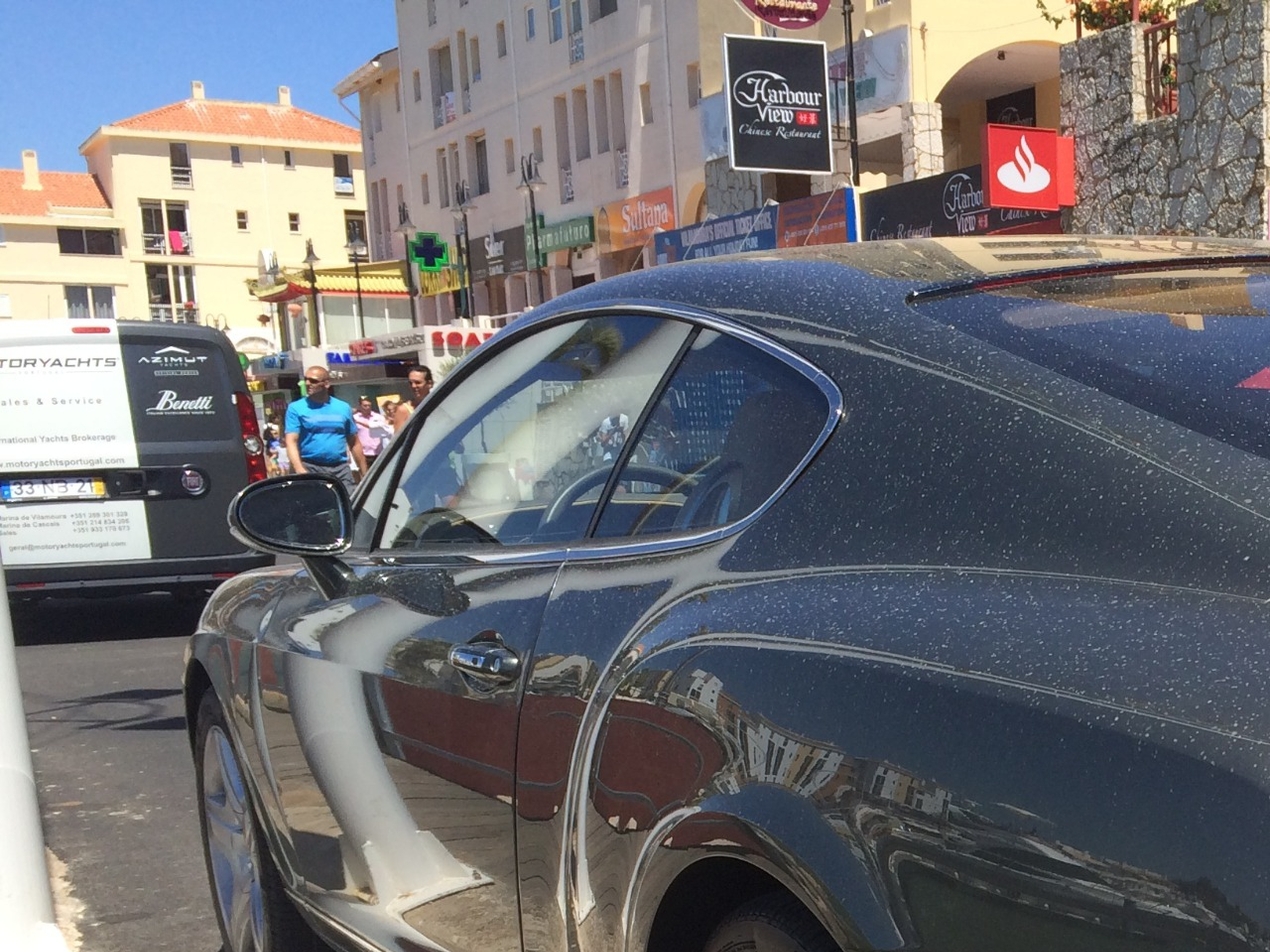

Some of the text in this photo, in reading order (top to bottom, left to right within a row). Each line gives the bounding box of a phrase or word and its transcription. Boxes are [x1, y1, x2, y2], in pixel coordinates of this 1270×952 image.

[737, 76, 822, 107] Harbour
[757, 102, 794, 125] View
[738, 119, 822, 140] Chinese Restaurant
[622, 200, 669, 233] Sultana
[138, 356, 208, 364] AZIMUT
[51, 395, 103, 406] Service
[145, 389, 213, 412] Benetti
[39, 434, 69, 444] Yachts
[71, 433, 117, 444] Brokerage
